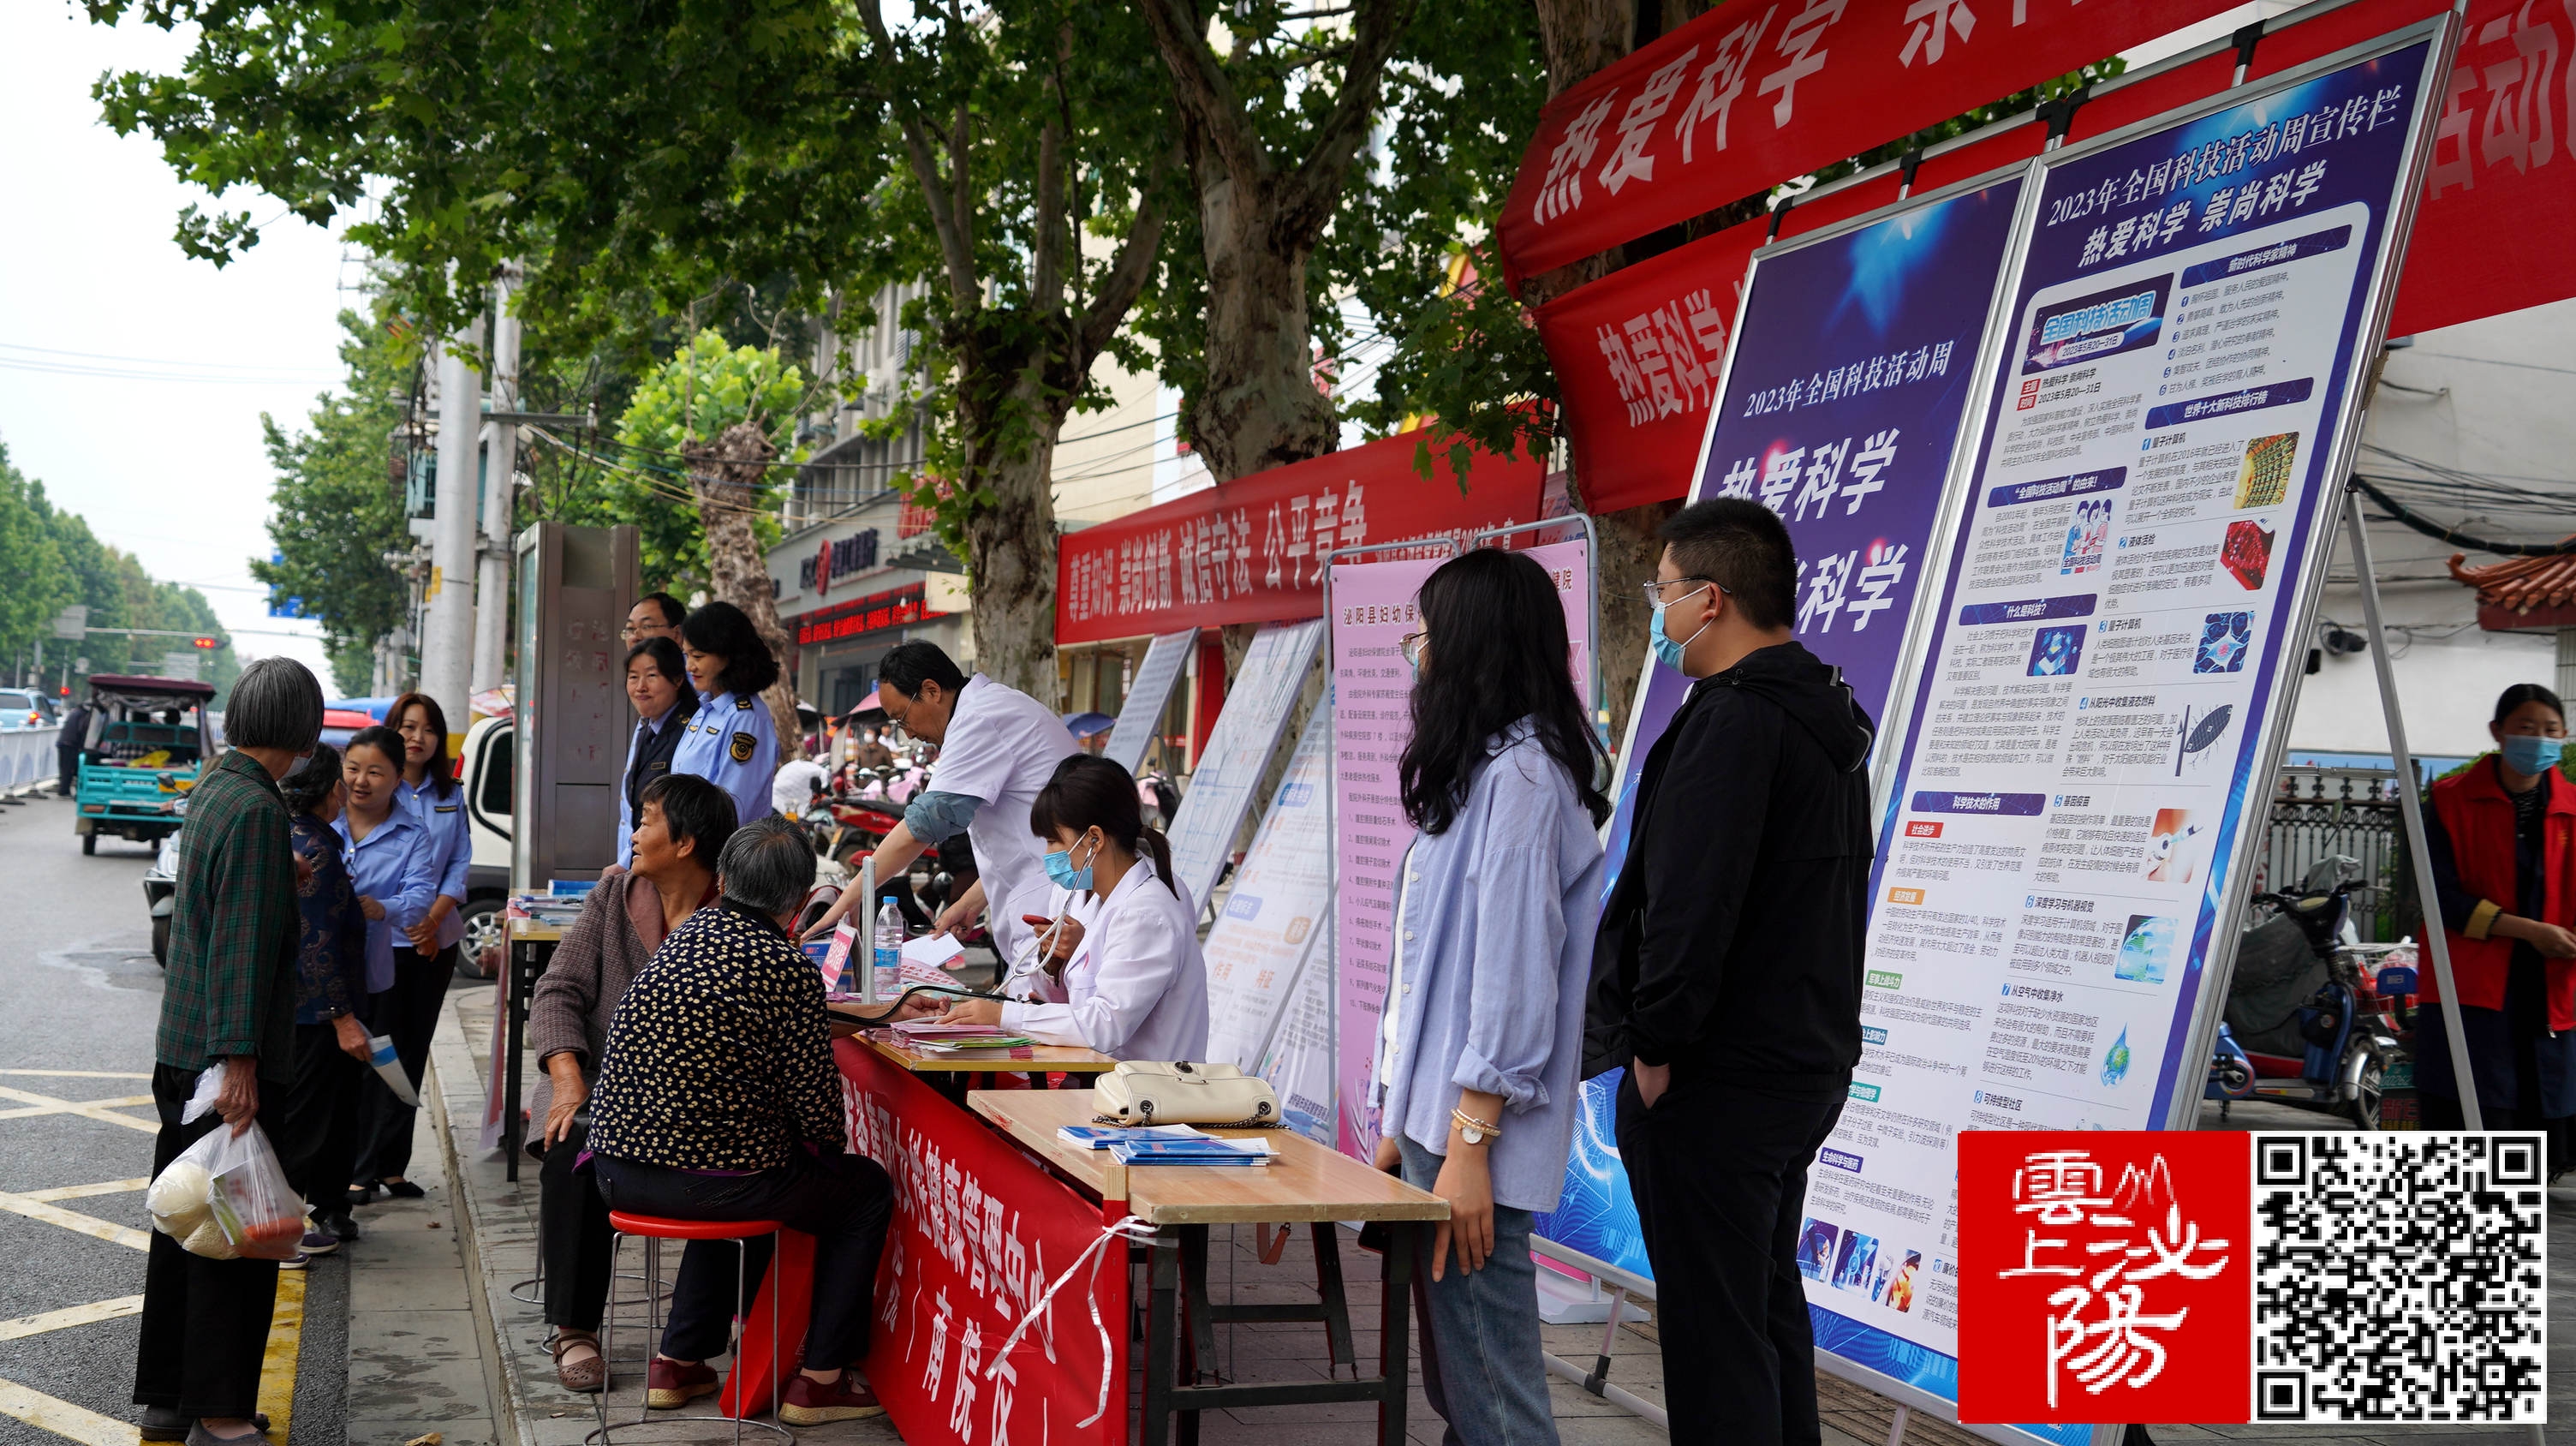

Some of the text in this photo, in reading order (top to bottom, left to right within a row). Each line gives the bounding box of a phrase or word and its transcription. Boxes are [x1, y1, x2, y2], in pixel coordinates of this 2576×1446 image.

[1534, 0, 1843, 225] 热爱科学
[2047, 84, 2403, 228] 2023年全国科技活动周宣传栏
[2077, 157, 2329, 268] 热爱科学 崇尚科学
[2227, 242, 2298, 273] 新时代科学家精神
[2040, 290, 2156, 344] 全国科技活动周
[1596, 288, 1726, 427] 热爱科学
[1744, 340, 1954, 417] 2023年全国科技活动周
[2183, 389, 2269, 419] 世界十大新科技排行榜
[2150, 431, 2186, 448] 量子计算机
[1118, 529, 1172, 616] 崇尚创新
[1179, 507, 1253, 605] 诚信守法
[1263, 479, 1368, 590] 公平竞争
[2127, 534, 2156, 547] 液体活检
[1795, 543, 1909, 635] 科学
[2107, 618, 2142, 632] 量子计算机
[2088, 694, 2156, 709] 从阳光中收集液态燃料
[1951, 796, 2001, 810] 科学技术的作用
[2062, 795, 2090, 807] 基因疫苗
[2033, 897, 2095, 912] 深度学习与机器视觉
[2010, 984, 2065, 1003] 从空气中收集净水
[1983, 1092, 2023, 1111] 可持续型社区
